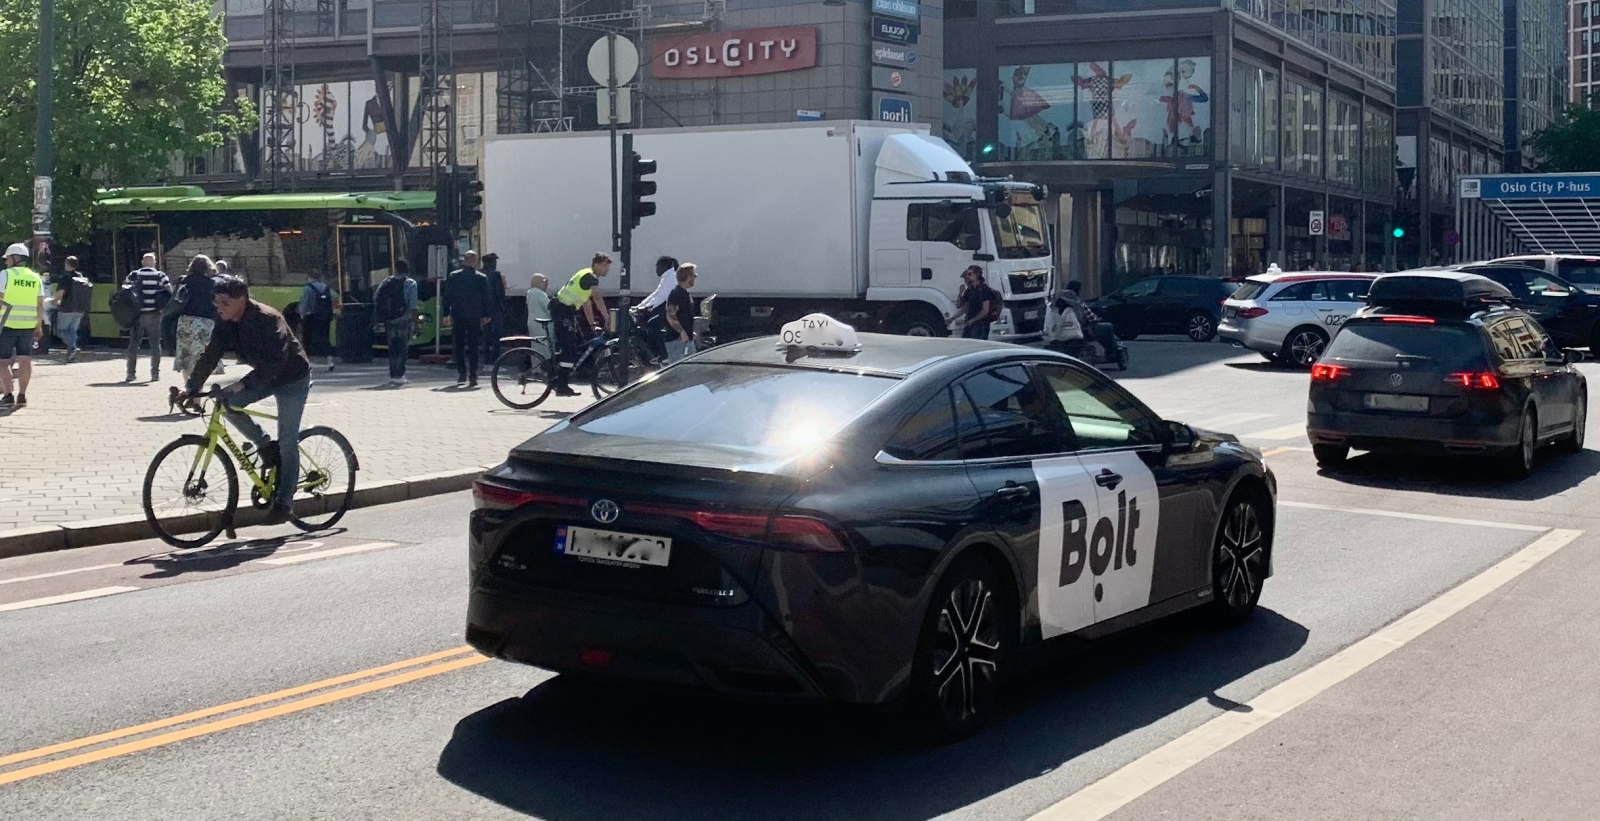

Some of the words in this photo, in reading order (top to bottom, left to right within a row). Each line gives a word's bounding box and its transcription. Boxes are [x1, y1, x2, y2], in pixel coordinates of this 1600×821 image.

[875, 47, 905, 61] eplehuset
[882, 106, 908, 122] norli
[1500, 181, 1527, 193] Oslo
[1530, 181, 1553, 195] City
[1557, 180, 1591, 193] P-hus
[14, 279, 36, 288] HENT
[221, 434, 255, 475] DIAMANT
[1059, 489, 1141, 589] Bolt
[577, 555, 596, 564] TOYOTA
